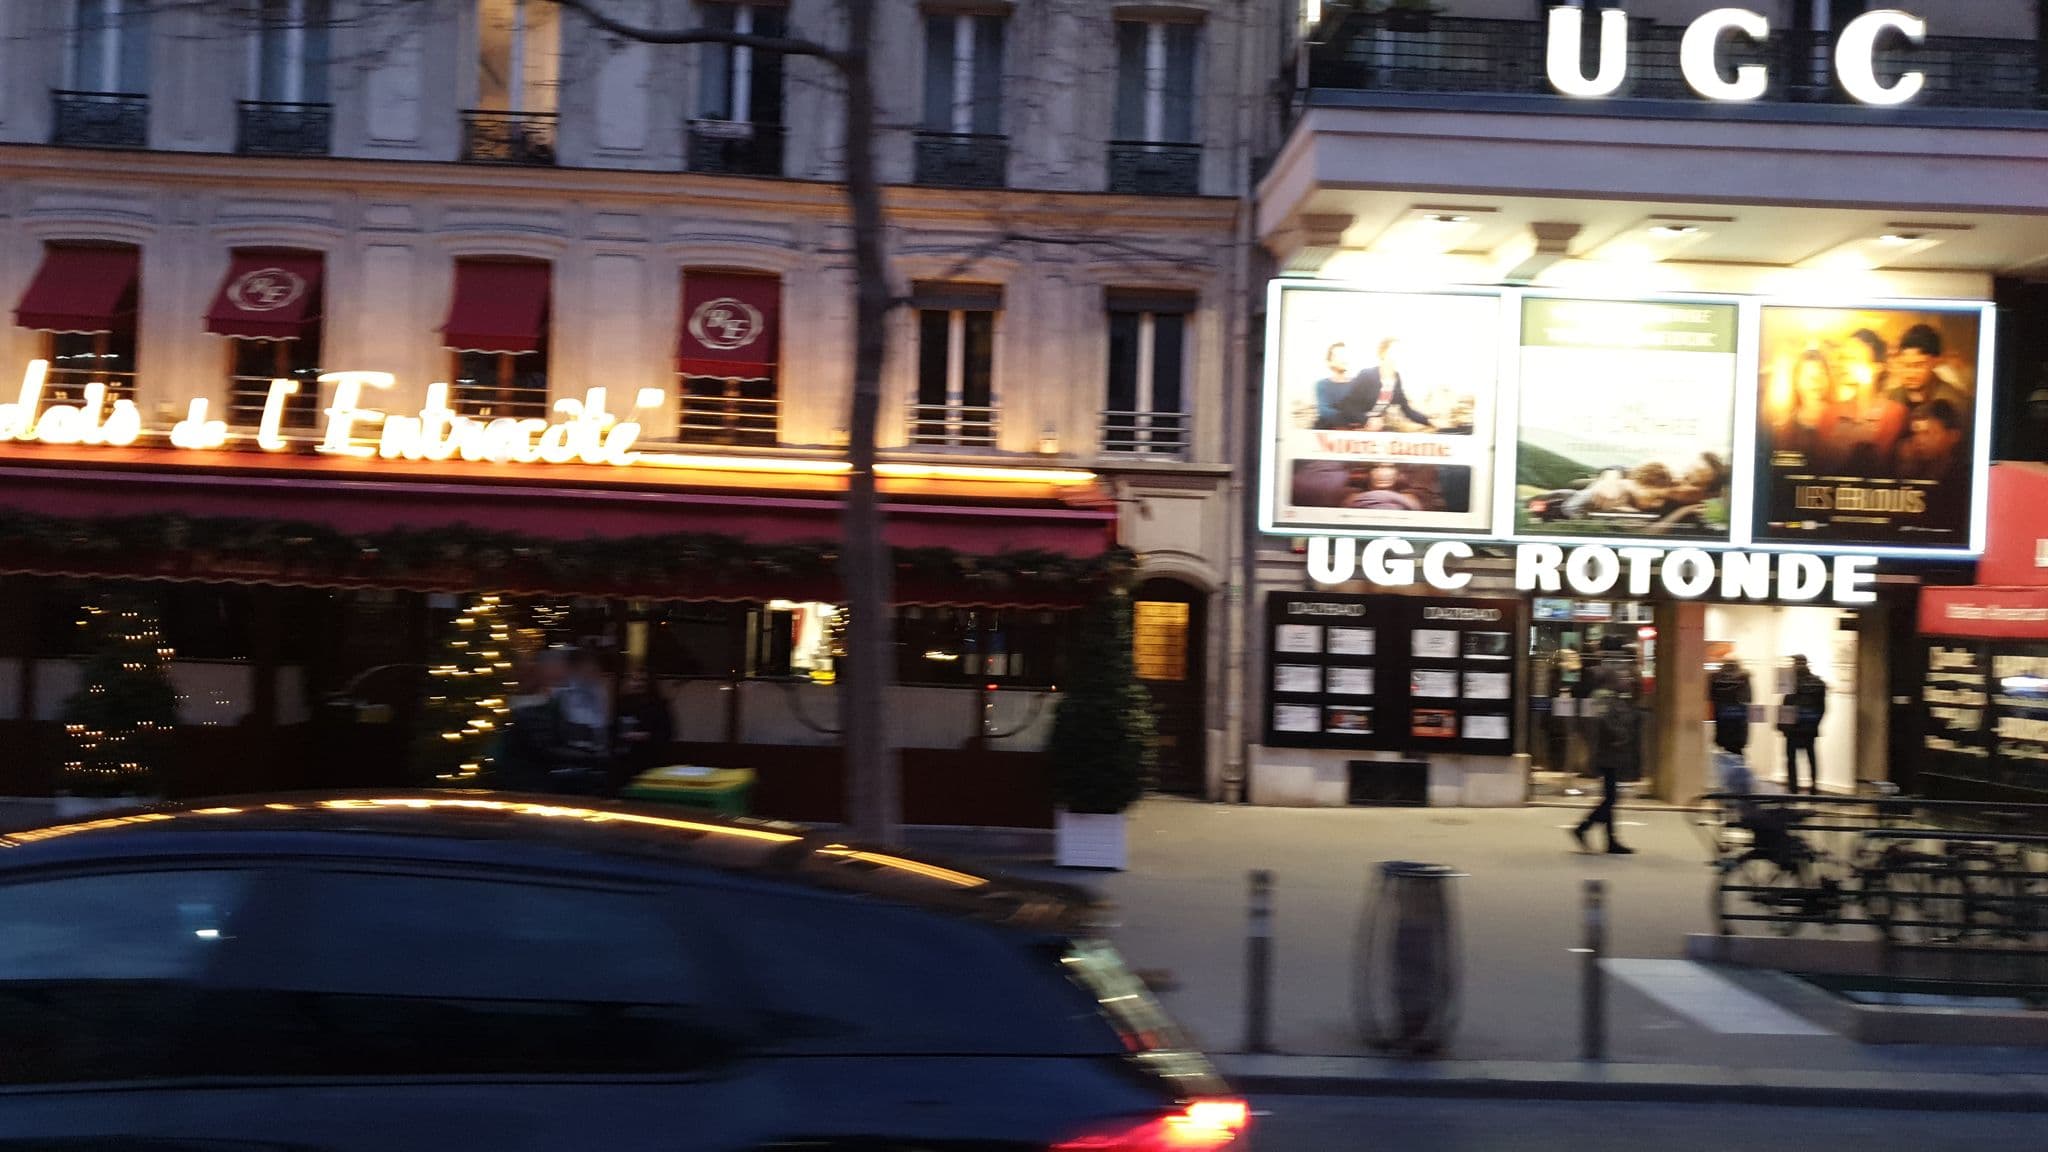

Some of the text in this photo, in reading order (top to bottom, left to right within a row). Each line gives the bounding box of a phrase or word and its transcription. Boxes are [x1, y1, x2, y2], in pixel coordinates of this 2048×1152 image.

[1546, 7, 1926, 106] UGC
[170, 397, 229, 449] de
[1306, 536, 1880, 603] UGC ROTONDE
